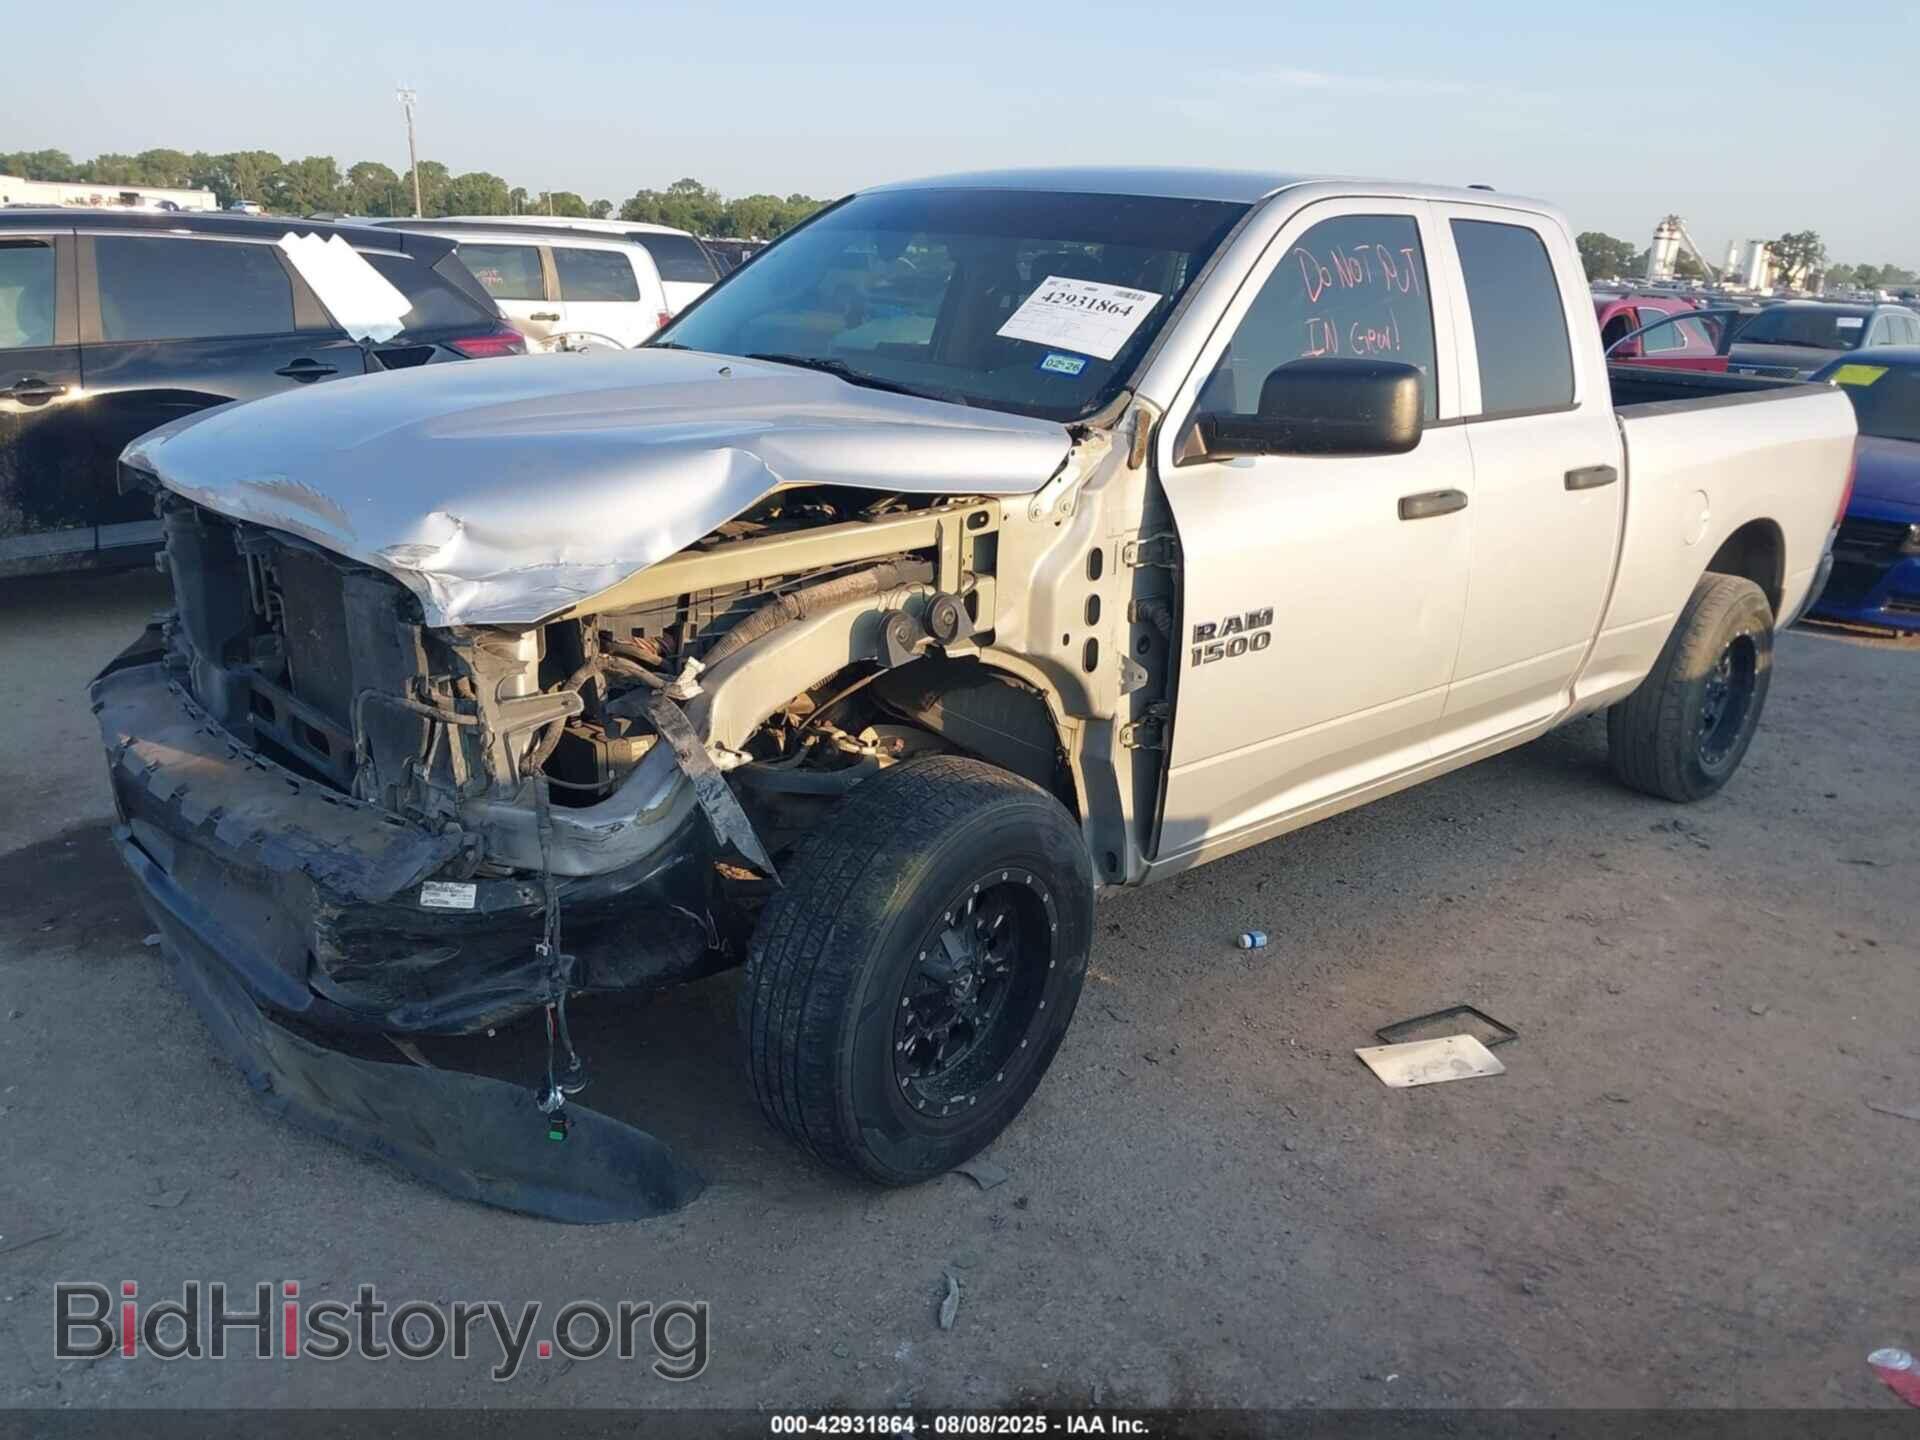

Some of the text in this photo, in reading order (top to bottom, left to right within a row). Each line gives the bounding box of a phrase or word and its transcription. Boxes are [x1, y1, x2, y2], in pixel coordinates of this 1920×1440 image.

[1331, 244, 1373, 289] NOT
[1376, 244, 1421, 297] PUT
[1041, 291, 1135, 317] 42931864
[1301, 317, 1339, 356] IN
[1192, 606, 1274, 645] RAM
[1191, 631, 1272, 667] 1500
